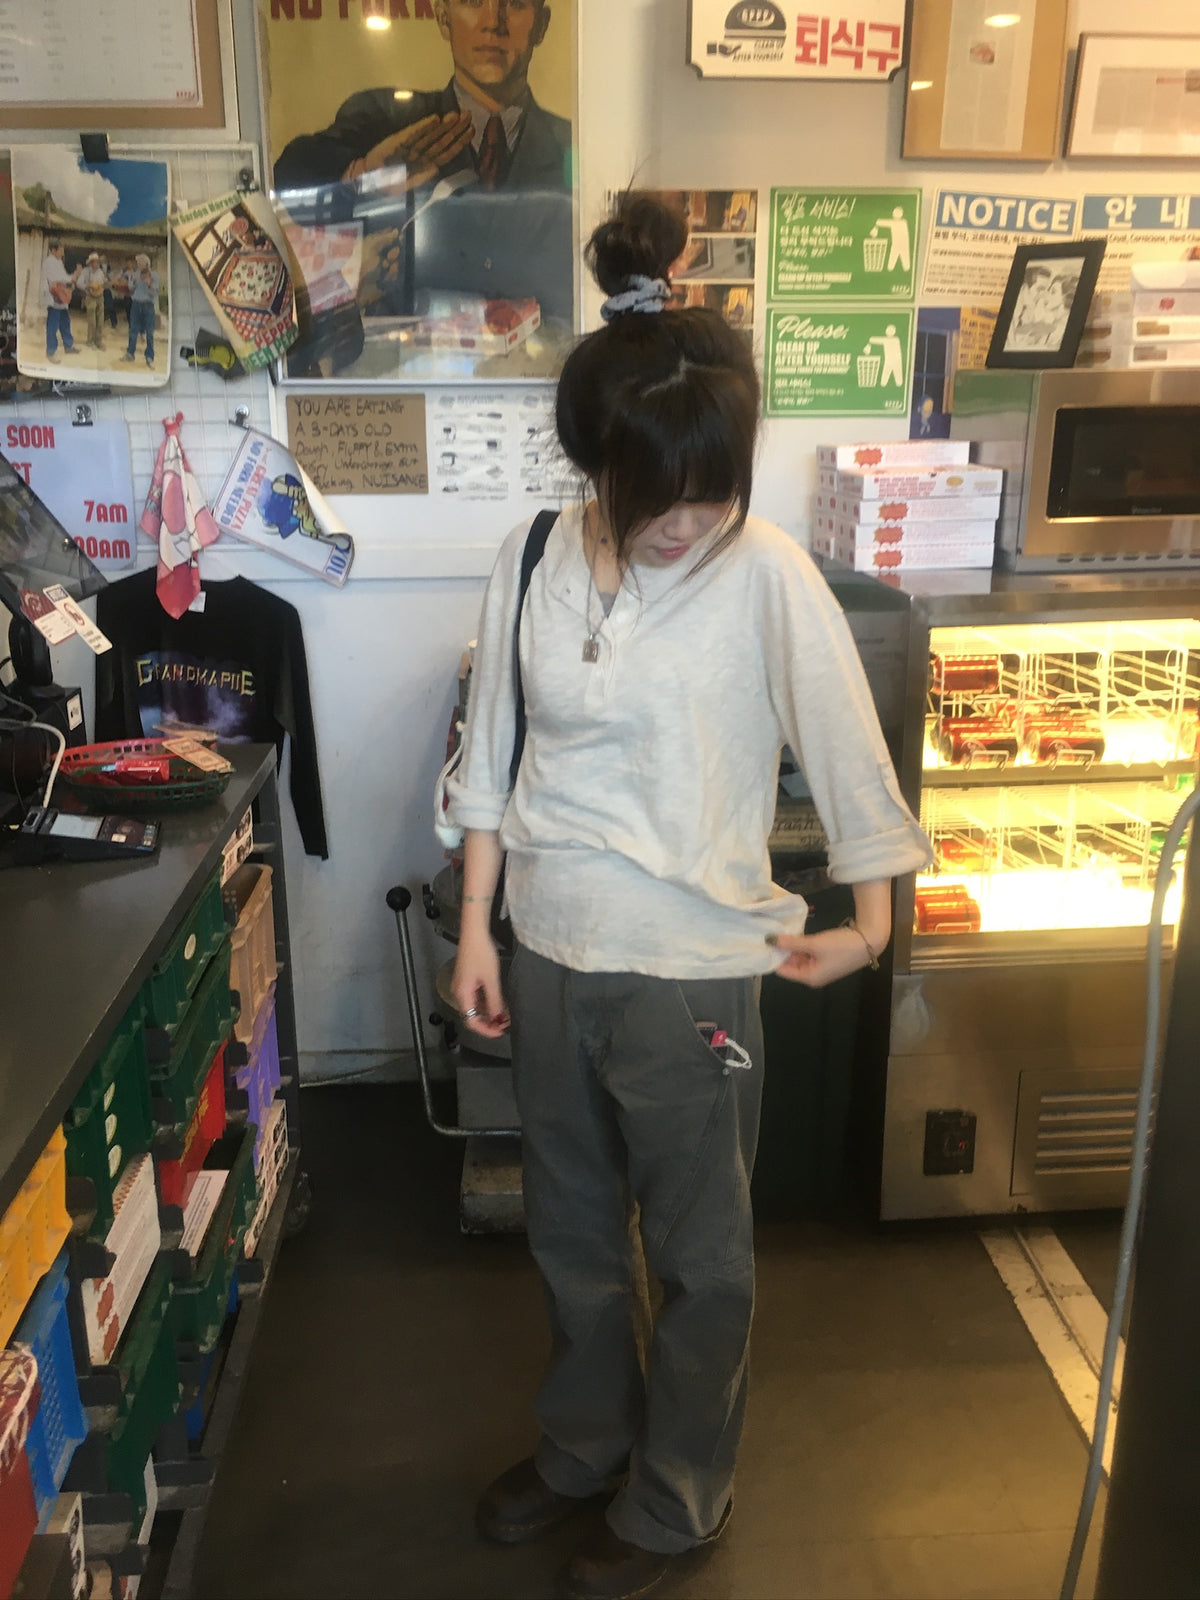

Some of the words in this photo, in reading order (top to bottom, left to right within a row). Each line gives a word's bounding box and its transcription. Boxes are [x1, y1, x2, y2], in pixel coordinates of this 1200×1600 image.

[794, 13, 901, 73] 퇴식구
[941, 194, 1072, 233] NOTICE
[776, 314, 850, 340] Please,
[775, 340, 805, 353] CLEAN
[806, 340, 821, 353] UP
[775, 353, 804, 366] AFTER
[805, 353, 851, 366] YOURSELF
[293, 399, 321, 417] YOU
[324, 398, 351, 417] ARE
[355, 398, 406, 416] EATING
[6, 424, 56, 449] SOON
[294, 421, 306, 437] A
[364, 422, 392, 437] OLD
[230, 499, 252, 530] PIZZA
